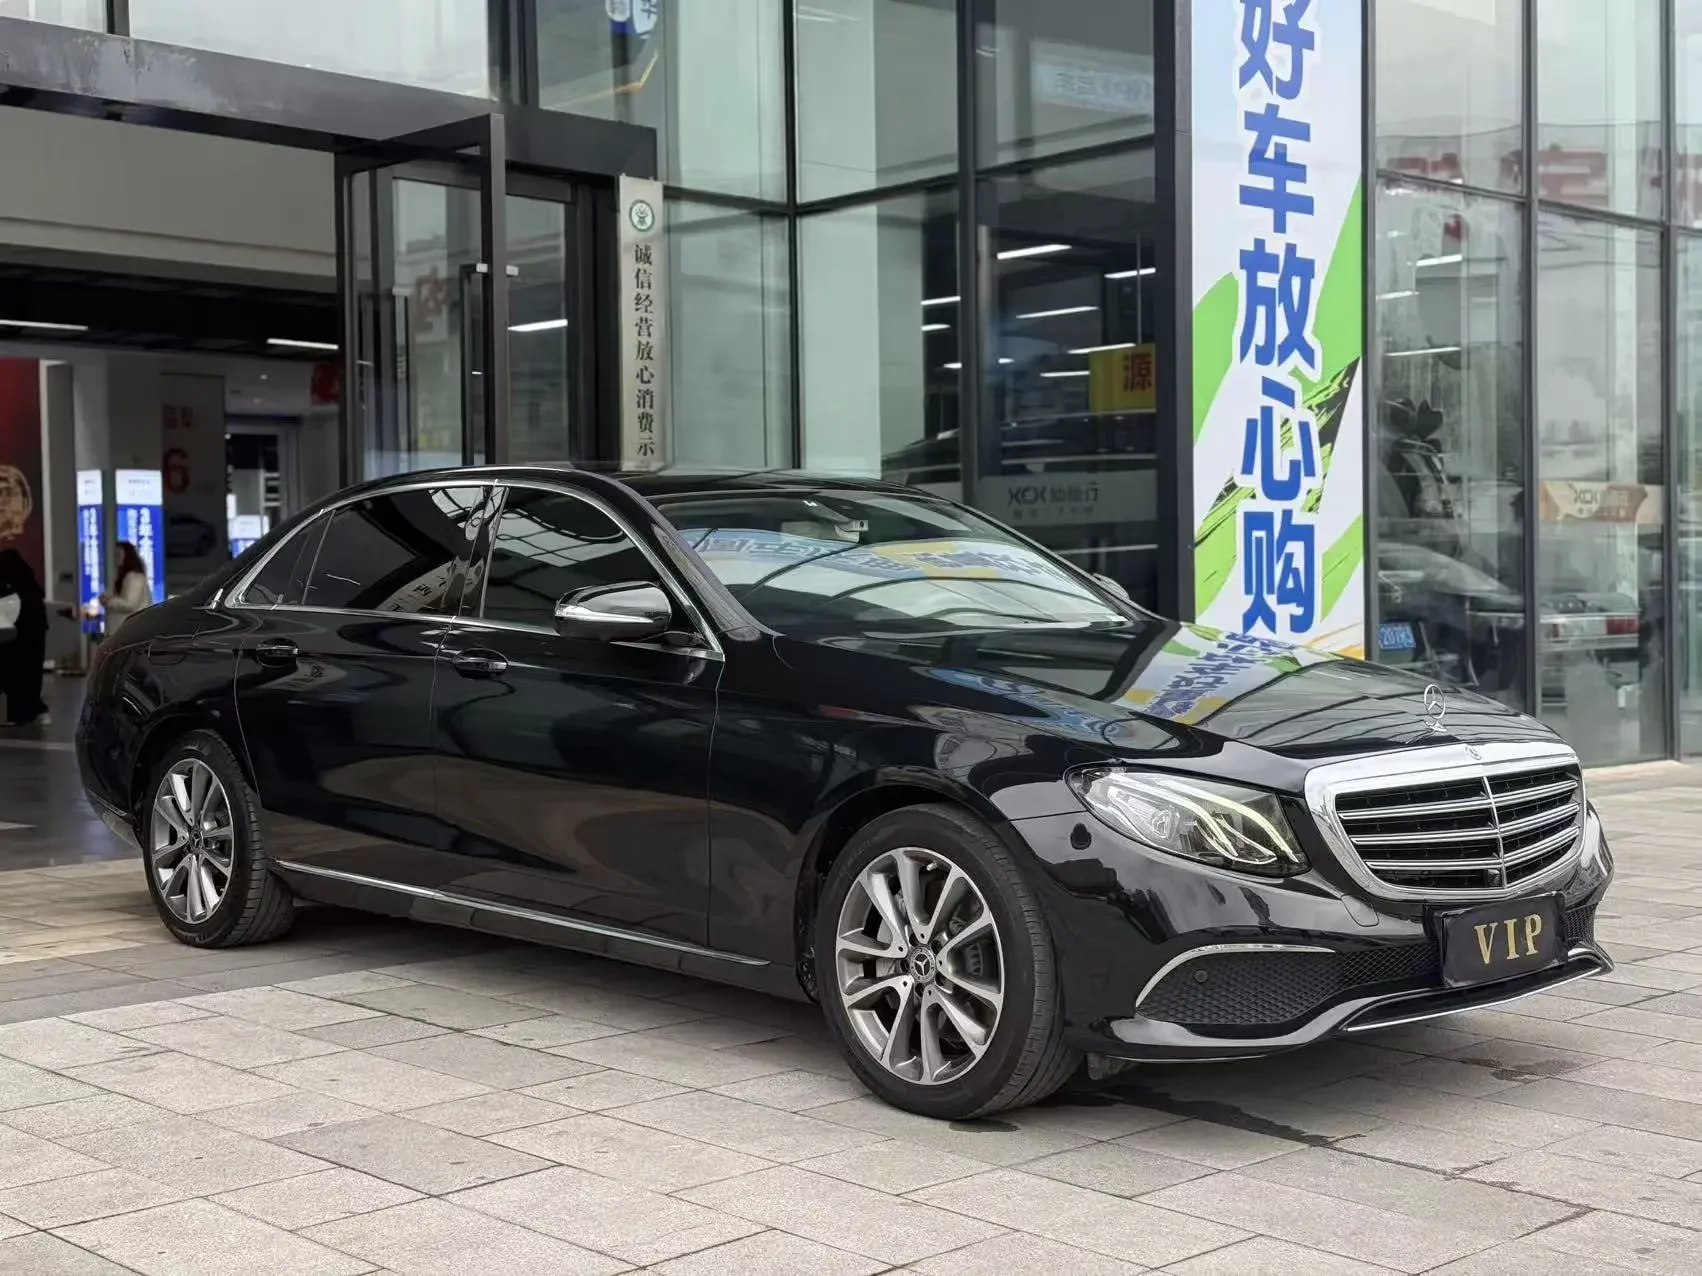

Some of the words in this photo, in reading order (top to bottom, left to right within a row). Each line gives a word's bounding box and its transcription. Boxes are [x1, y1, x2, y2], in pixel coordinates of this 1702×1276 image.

[1238, 0, 1316, 635] 好车放心购
[1474, 914, 1542, 965] VIP
